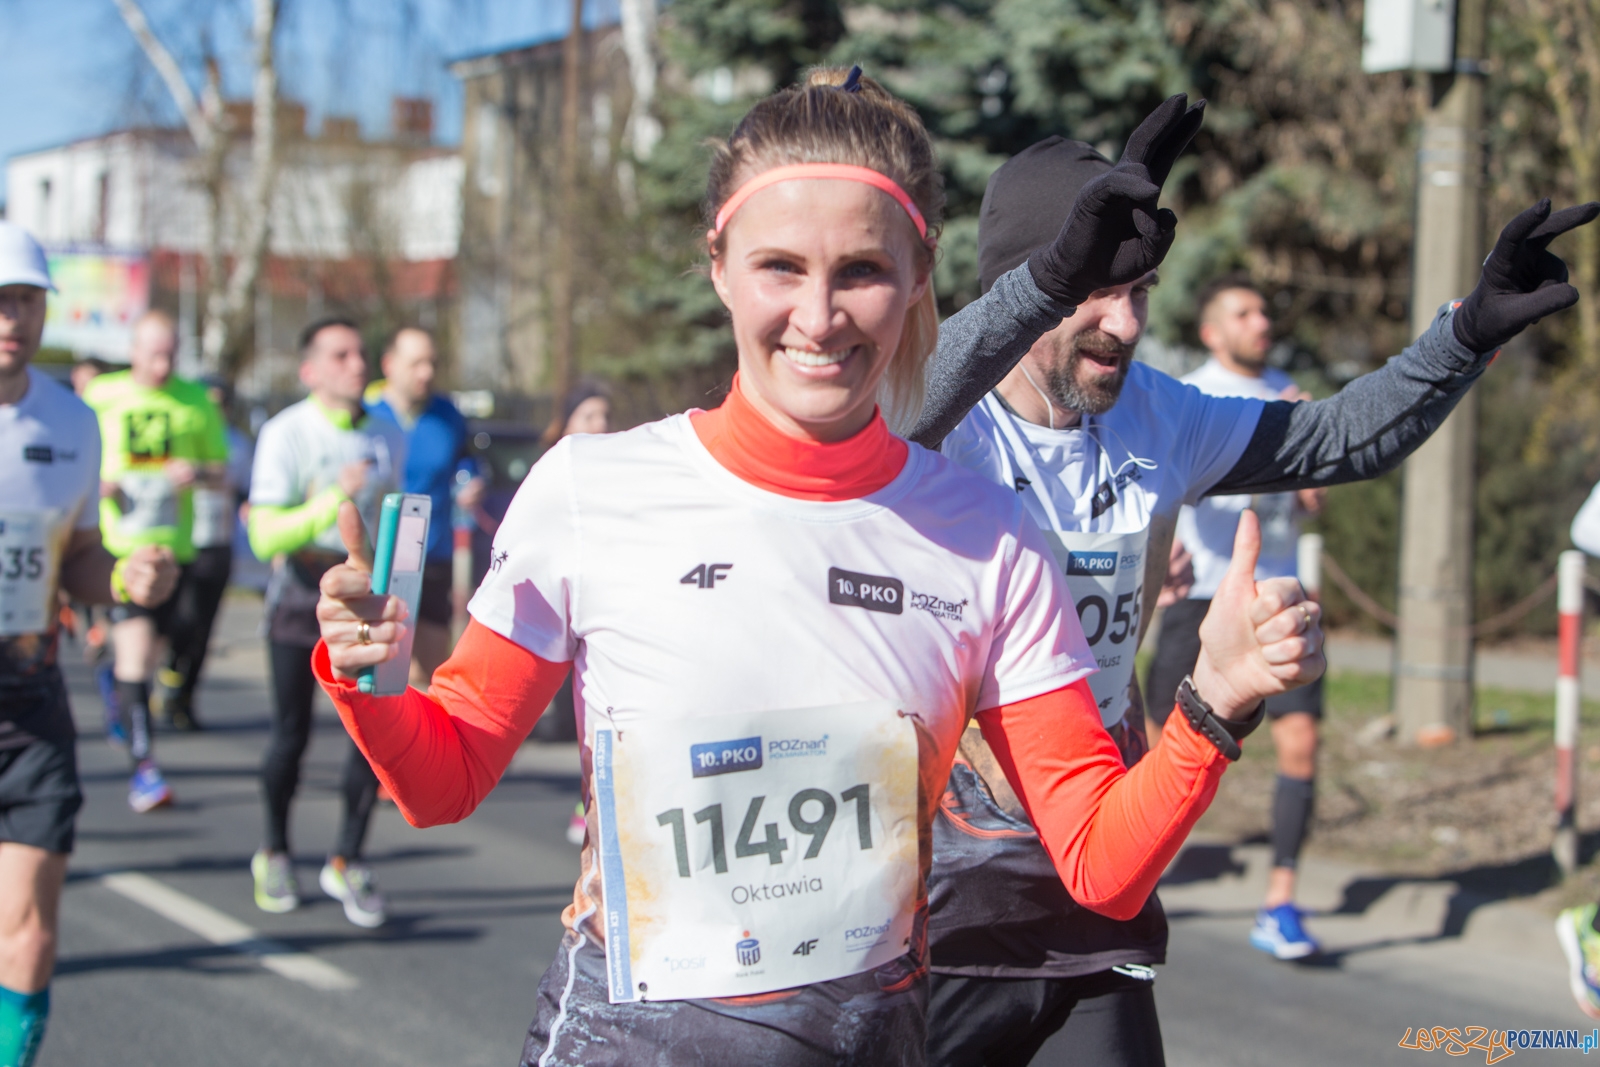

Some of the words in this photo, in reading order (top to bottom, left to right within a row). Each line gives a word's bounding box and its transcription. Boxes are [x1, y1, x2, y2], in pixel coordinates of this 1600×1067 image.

[0, 547, 43, 580] 35
[679, 563, 733, 589] 4F
[1095, 655, 1122, 669] riusz
[656, 783, 873, 878] 11491
[731, 875, 823, 904] Oktawia
[792, 938, 819, 956] 4F
